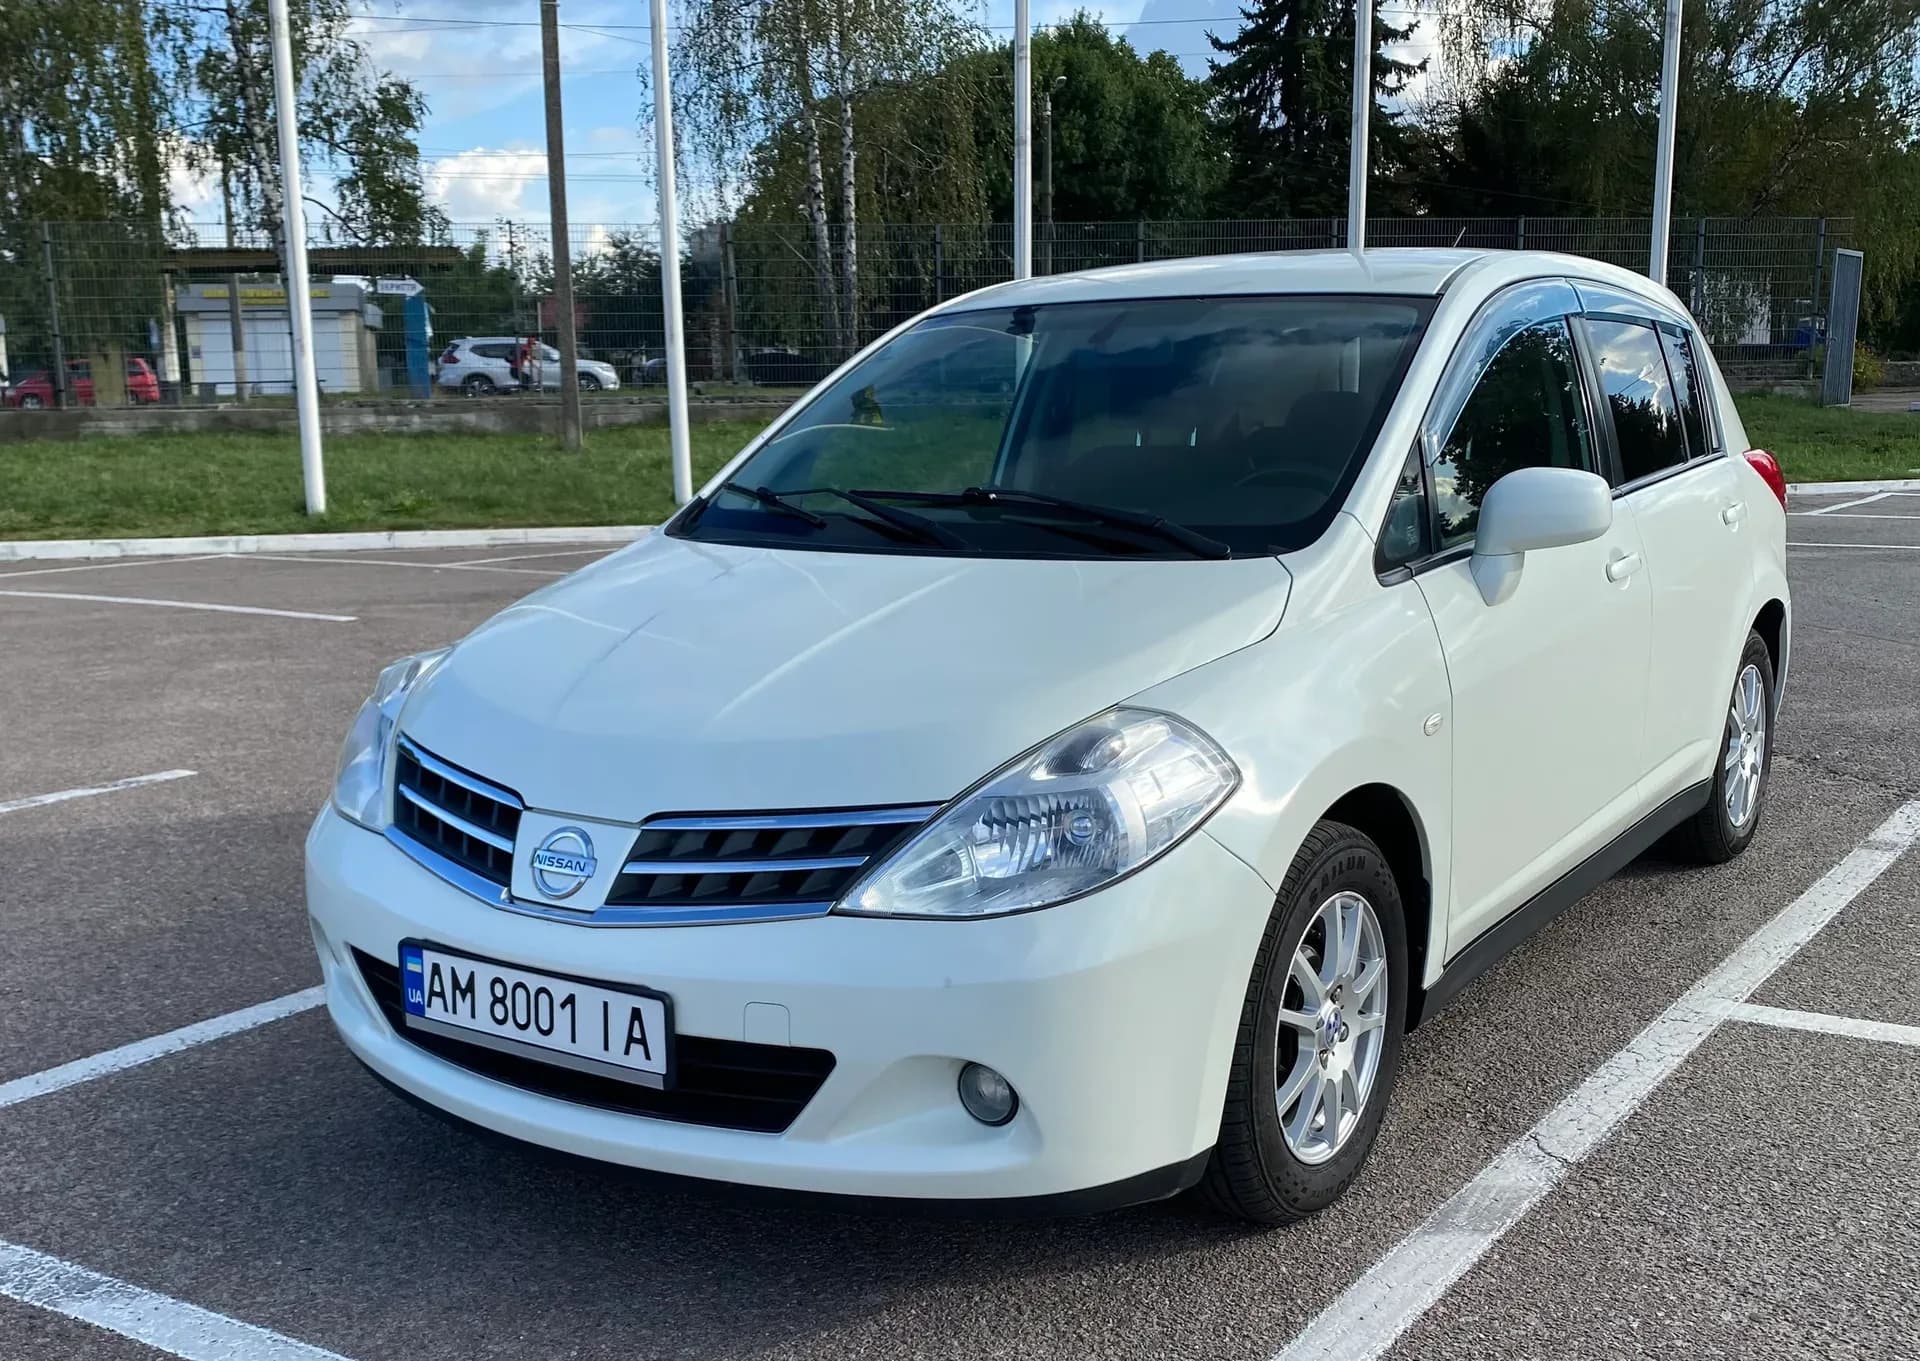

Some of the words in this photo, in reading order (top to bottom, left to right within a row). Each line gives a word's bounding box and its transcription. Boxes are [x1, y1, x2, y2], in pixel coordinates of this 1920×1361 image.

[534, 854, 586, 873] NISSAN
[1309, 855, 1366, 909] SAILUN
[408, 987, 424, 1006] UA
[426, 962, 477, 1020] AM
[489, 976, 577, 1045] 8001
[602, 1000, 652, 1061] IA
